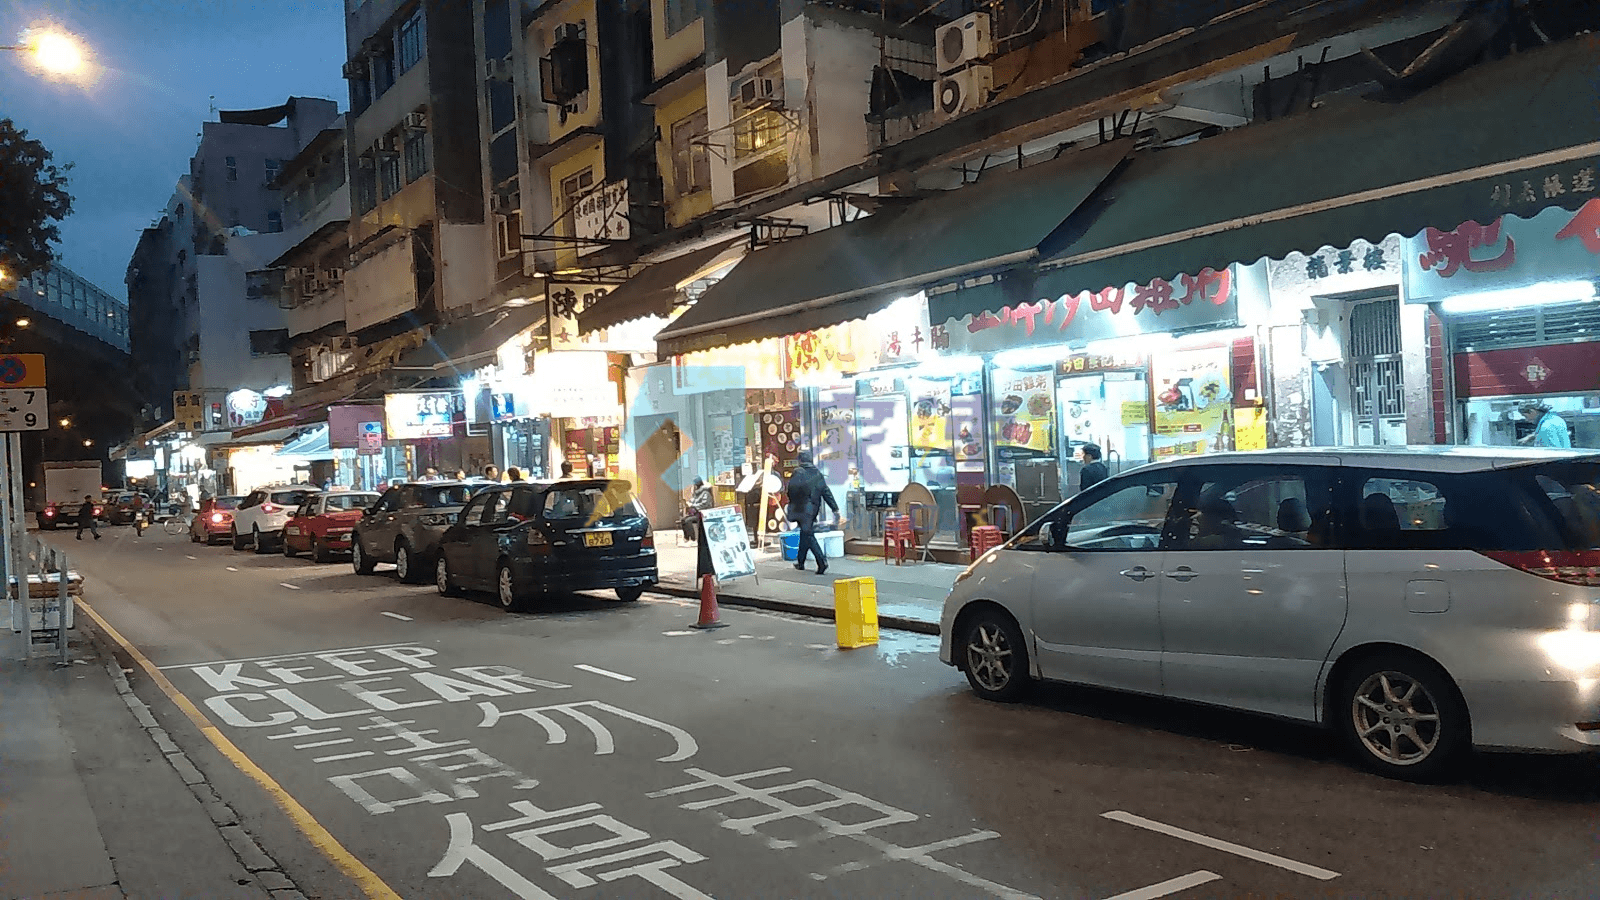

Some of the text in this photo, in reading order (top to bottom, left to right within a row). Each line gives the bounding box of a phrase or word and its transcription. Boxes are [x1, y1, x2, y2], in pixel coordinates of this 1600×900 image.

[24, 391, 35, 405] 7
[25, 412, 37, 427] 9
[190, 646, 437, 691] KEEP
[203, 665, 573, 728] CLEAR
